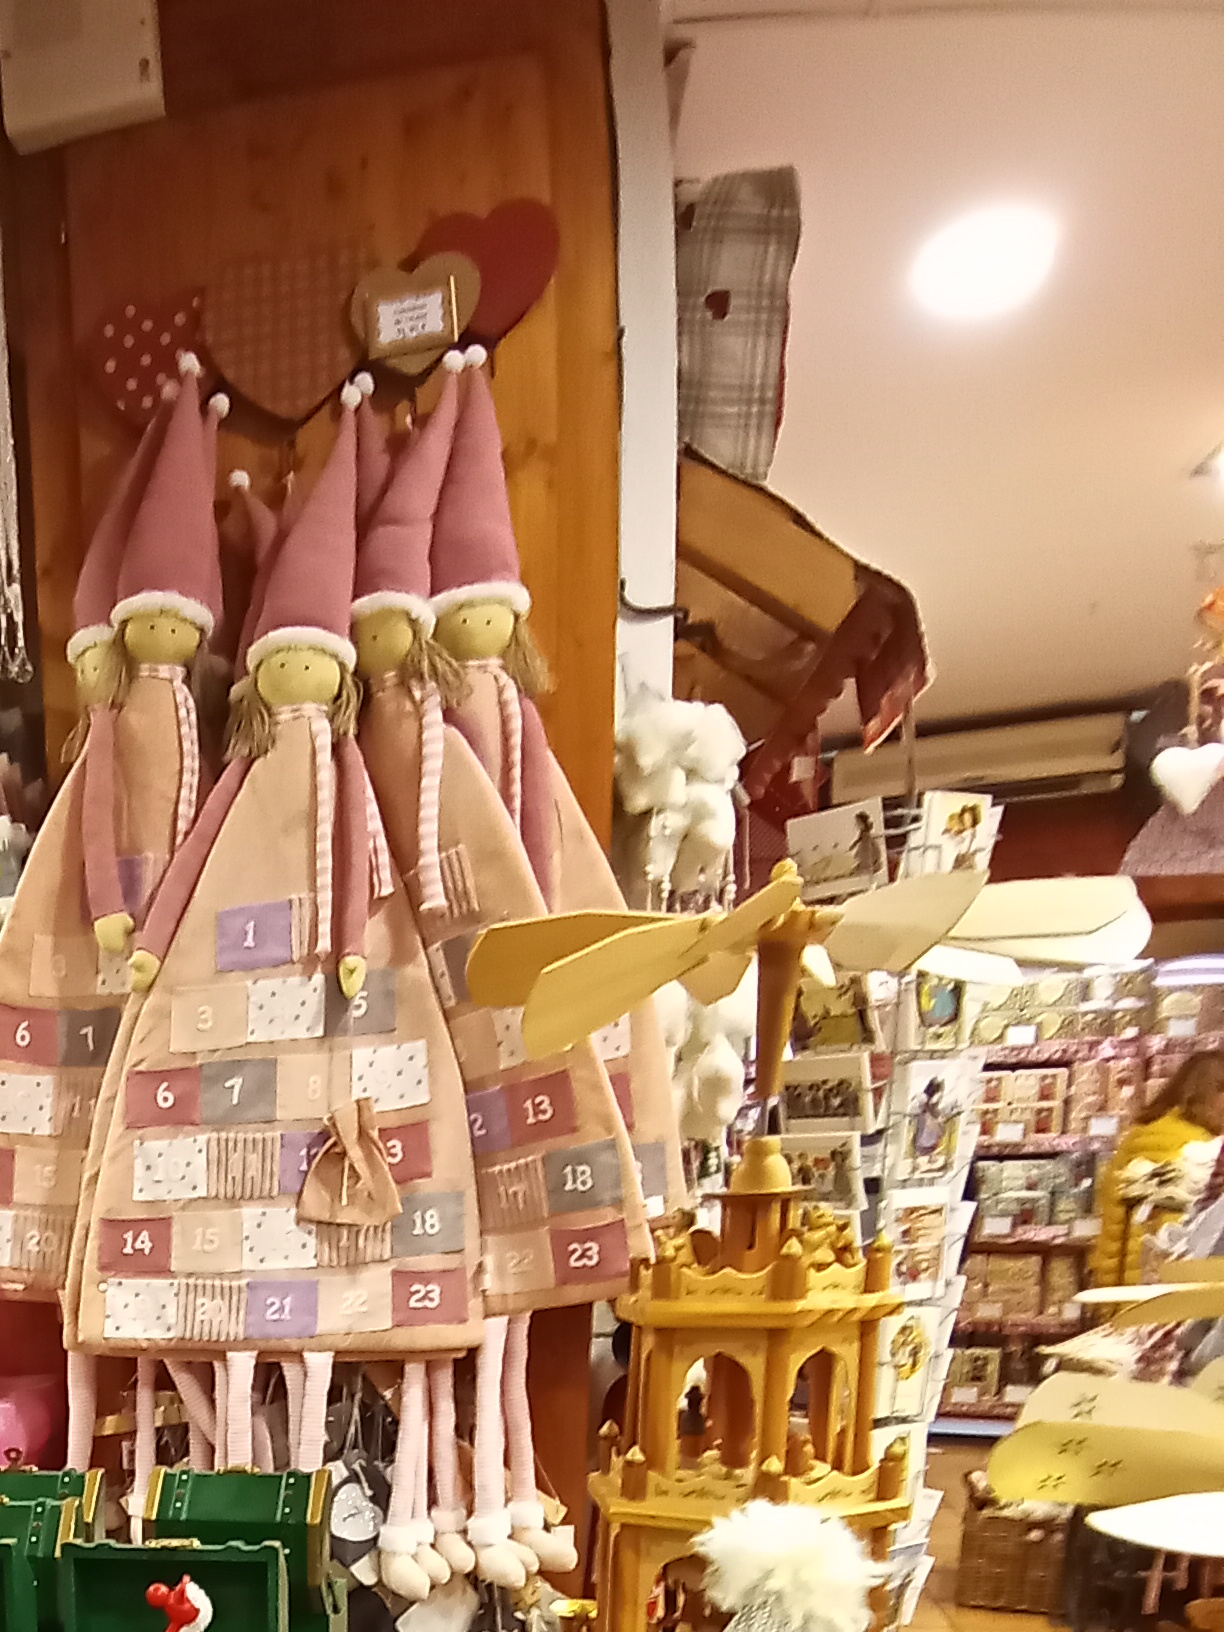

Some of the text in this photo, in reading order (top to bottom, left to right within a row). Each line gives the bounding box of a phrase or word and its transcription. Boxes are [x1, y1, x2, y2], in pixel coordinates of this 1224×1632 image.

[243, 919, 256, 950] 1
[197, 1004, 214, 1032] 3
[352, 990, 369, 1019] 5
[15, 1021, 31, 1048] 6
[79, 1025, 94, 1051] 7
[156, 1081, 175, 1109] 6
[223, 1076, 244, 1106] 7
[308, 1075, 322, 1100] 8
[523, 1094, 555, 1126] 13
[469, 1113, 487, 1138] 2
[386, 1139, 403, 1165] 3
[562, 1164, 594, 1192] 18
[412, 1207, 443, 1236] 18
[122, 1230, 153, 1256] 14
[192, 1227, 220, 1253] 15
[567, 1241, 600, 1268] 23
[265, 1296, 292, 1322] 21
[342, 1291, 369, 1316] 22
[408, 1283, 442, 1310] 23
